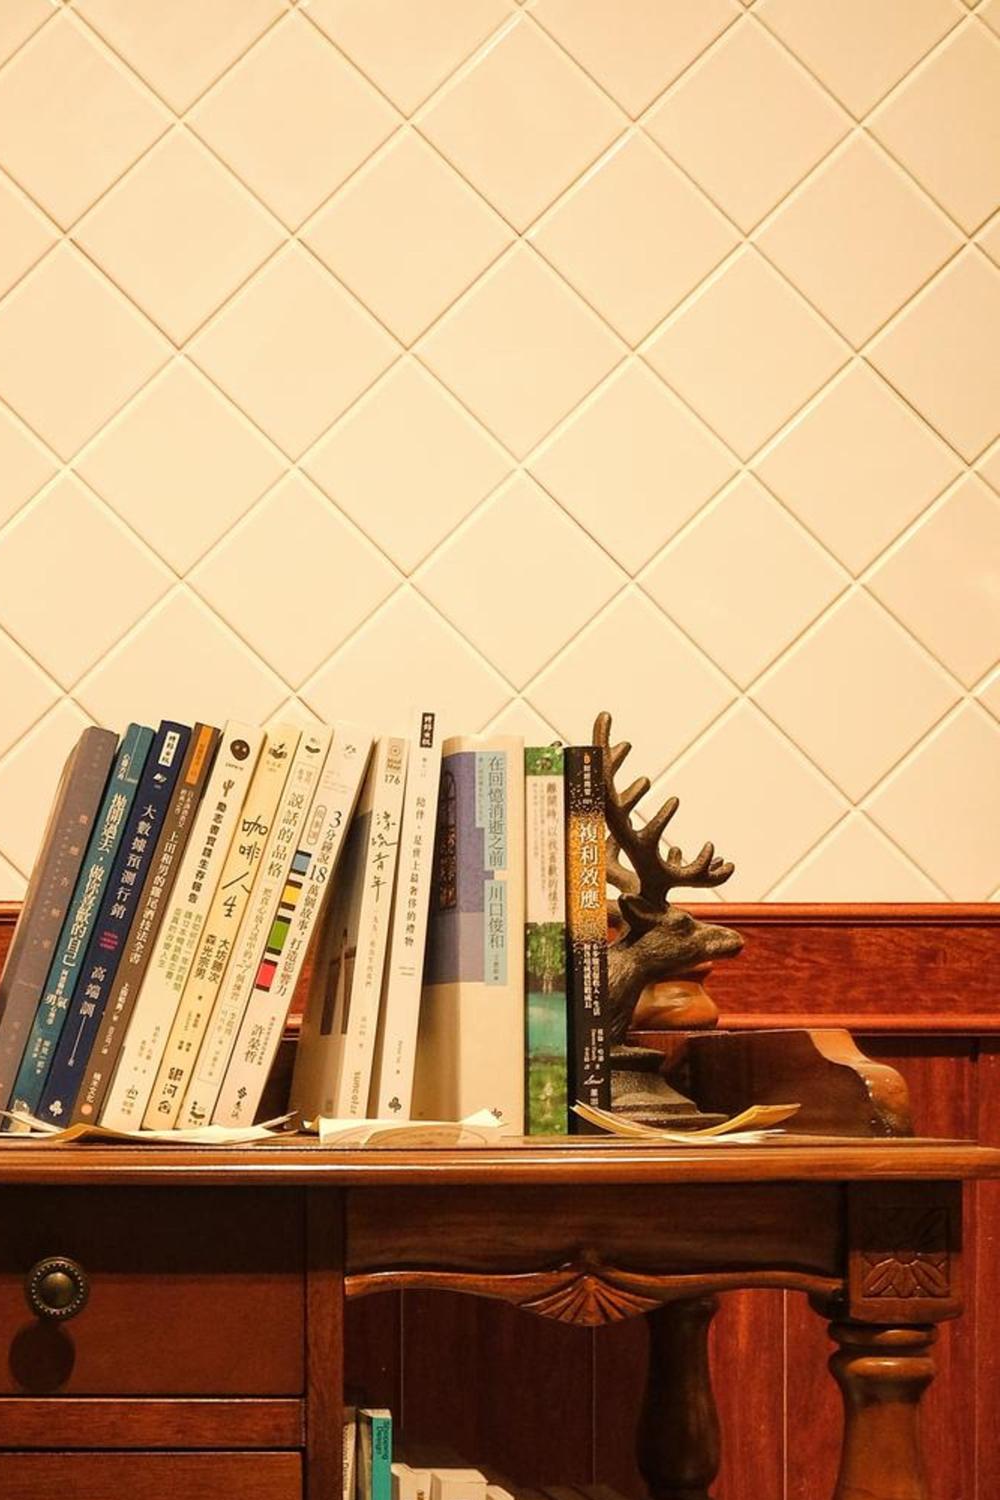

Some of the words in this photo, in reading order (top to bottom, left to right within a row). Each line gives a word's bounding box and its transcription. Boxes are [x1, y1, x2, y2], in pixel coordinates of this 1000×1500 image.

[384, 774, 401, 785] 176
[488, 755, 504, 868] 在回憶消逝之前
[110, 804, 157, 919] 大數據預測行銷
[221, 815, 268, 919] 咖啡人生
[268, 792, 304, 879] 說話的品格
[579, 821, 600, 909] 複利效應
[488, 887, 504, 949] 川口俊和
